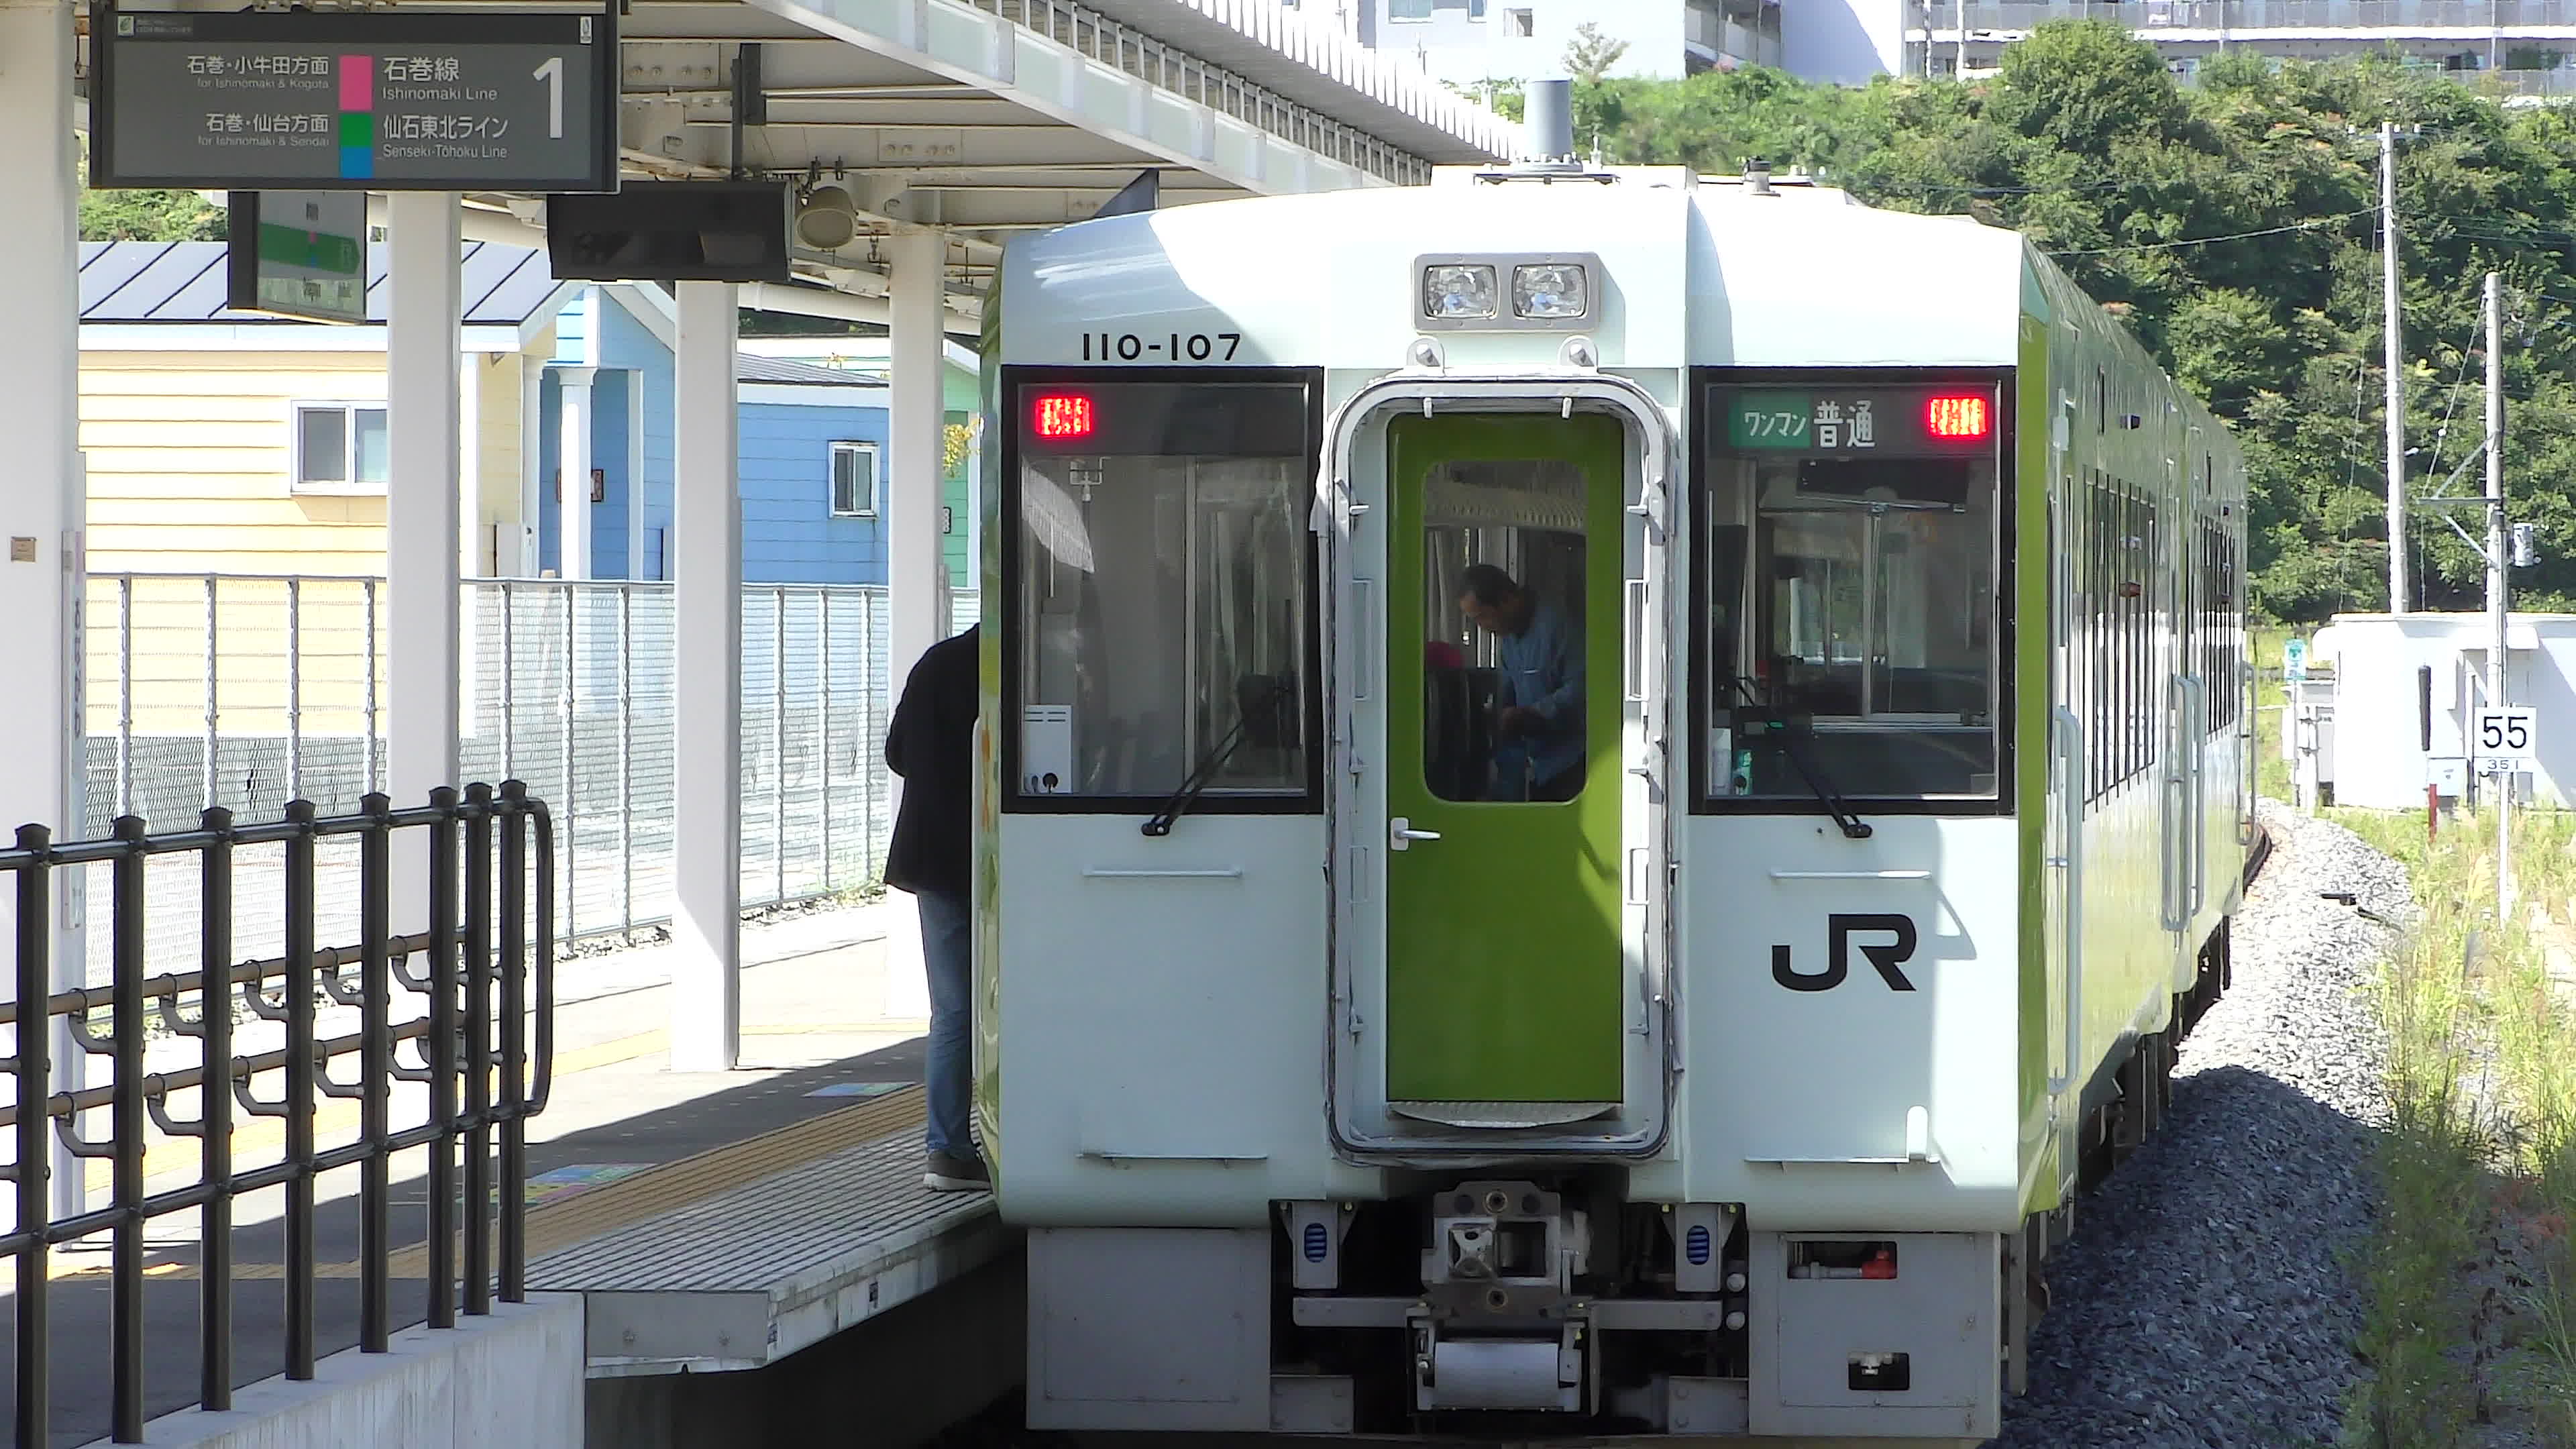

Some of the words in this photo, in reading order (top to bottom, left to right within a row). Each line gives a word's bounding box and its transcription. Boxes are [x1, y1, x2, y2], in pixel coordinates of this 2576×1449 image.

[383, 57, 460, 82] 石巻線
[382, 87, 461, 100] Ishinomaki
[466, 87, 498, 100] Line
[533, 57, 563, 139] 1
[383, 114, 508, 140] 仙石東北ライン
[482, 144, 507, 158] Line
[1083, 333, 1240, 362] 110-107
[1744, 412, 1807, 437] ワンマン
[1813, 400, 1876, 447] 普通
[2483, 716, 2528, 749] 55
[1771, 913, 1917, 991] JR
